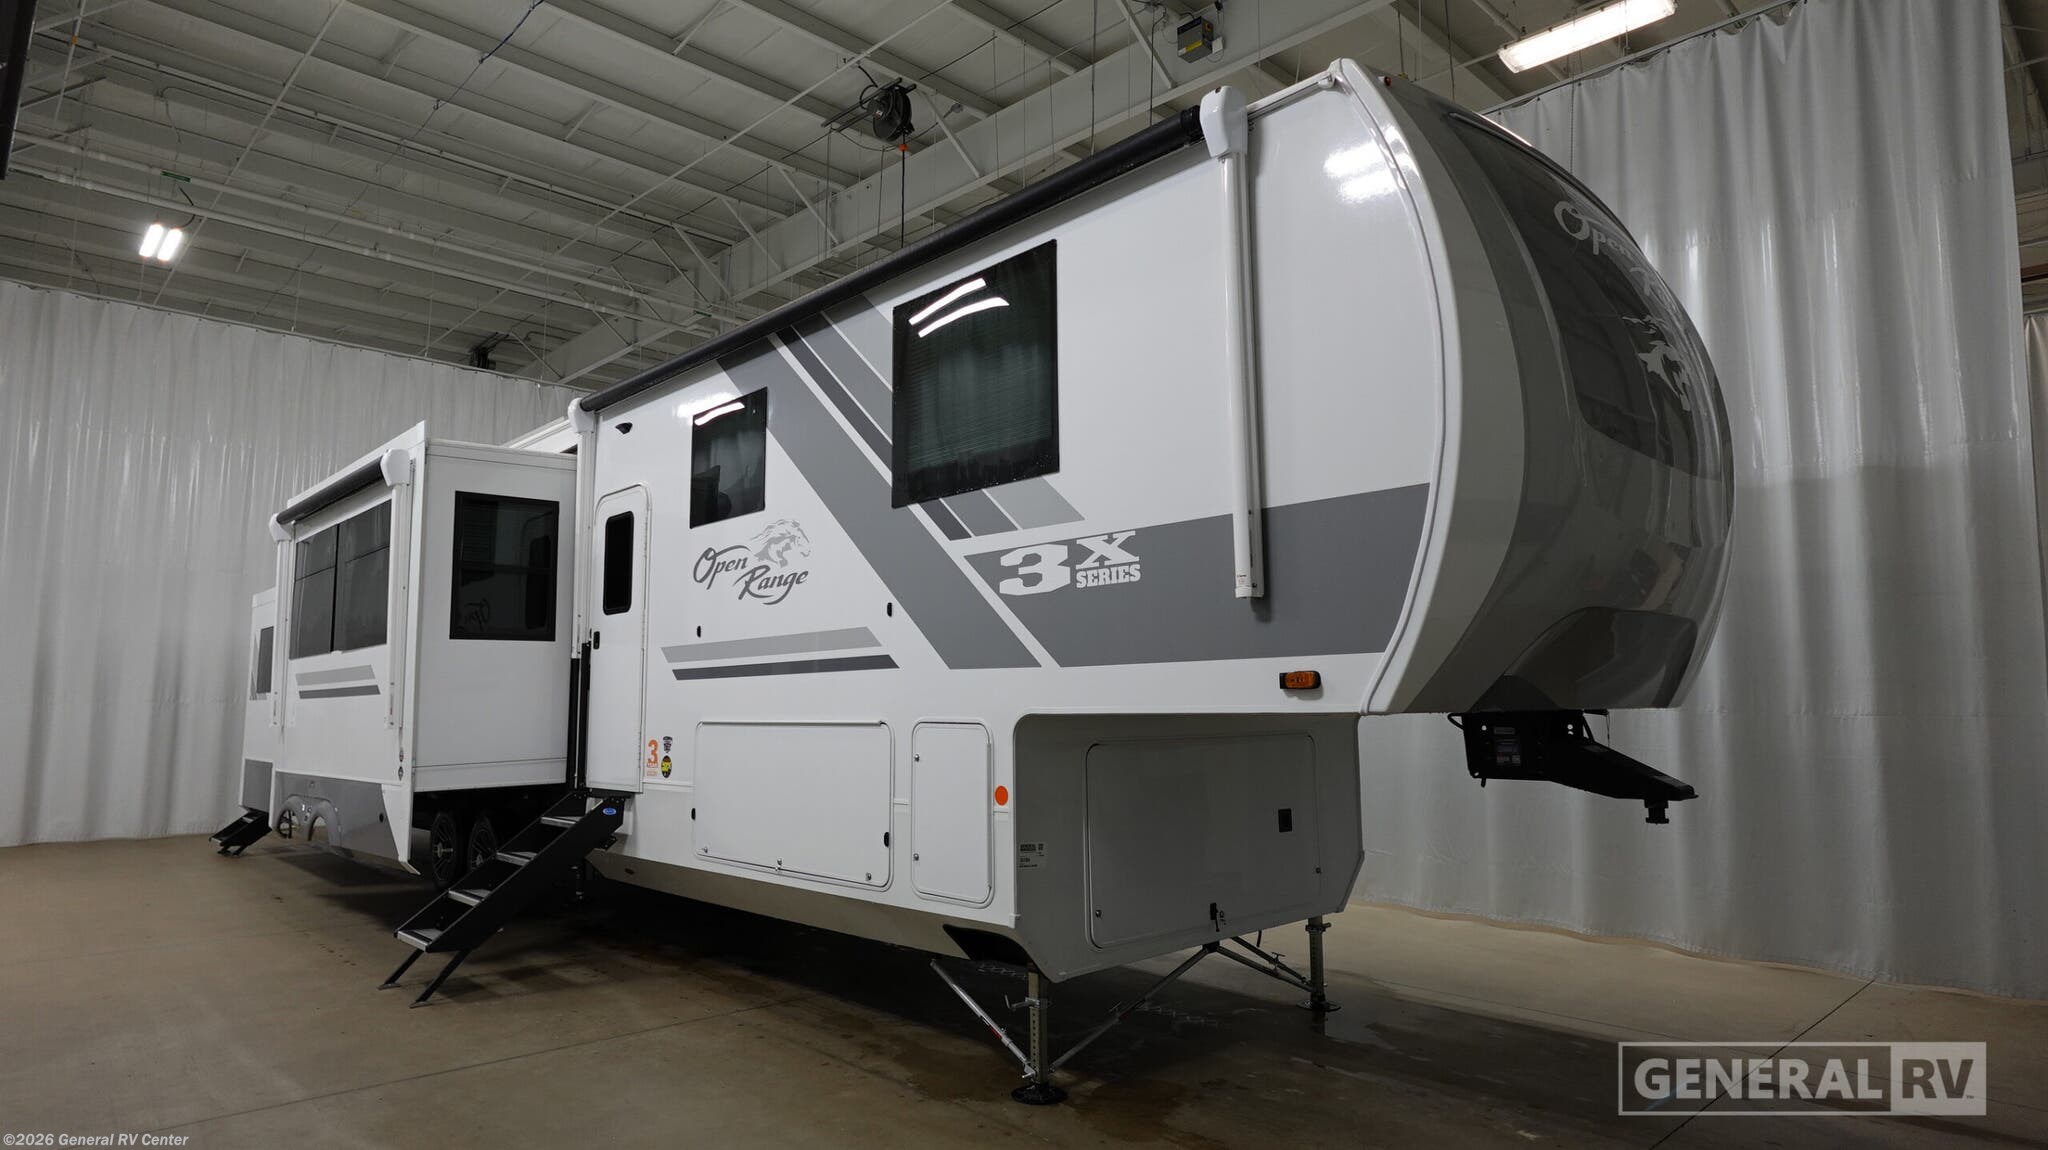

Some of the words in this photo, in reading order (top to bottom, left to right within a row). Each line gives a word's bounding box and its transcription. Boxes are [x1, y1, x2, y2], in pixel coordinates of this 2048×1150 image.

[693, 545, 751, 590] Open
[1076, 565, 1141, 588] SERIES
[733, 565, 809, 605] Range
[647, 739, 659, 763] 3
